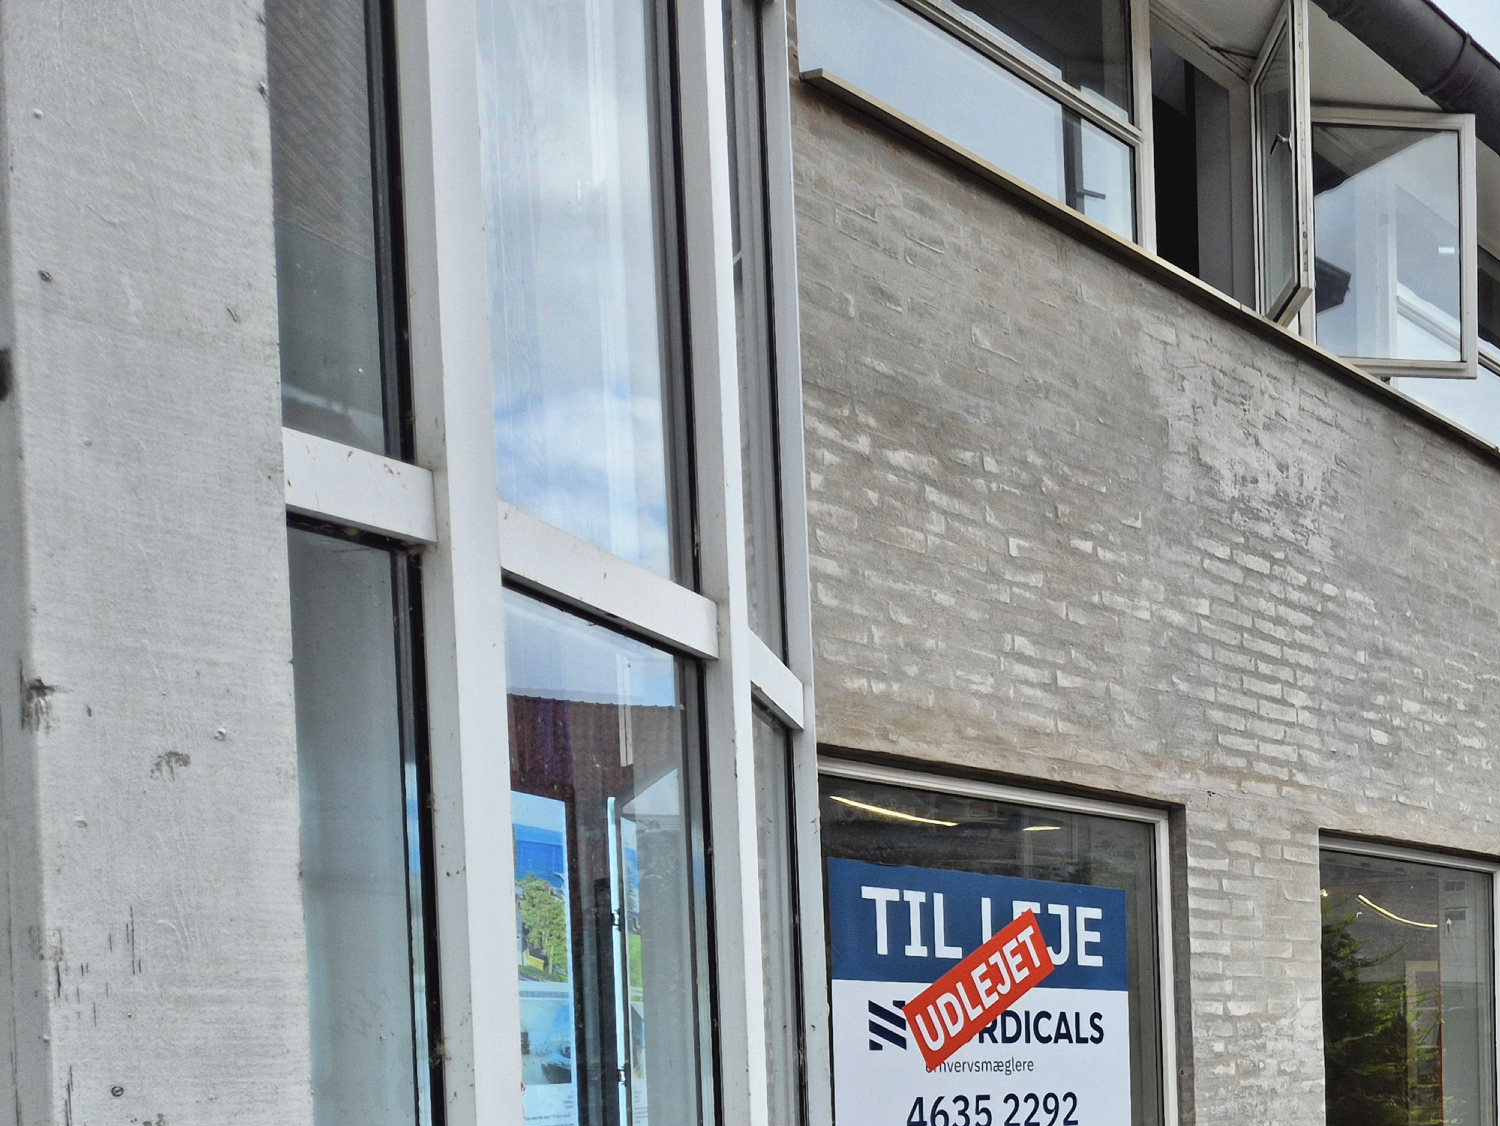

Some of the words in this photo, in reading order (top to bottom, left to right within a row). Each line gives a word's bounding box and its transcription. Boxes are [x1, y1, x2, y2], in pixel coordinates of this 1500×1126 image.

[861, 886, 963, 959] TIL
[915, 925, 1041, 1051] UDLEJET
[966, 1010, 1104, 1045] RDICALS
